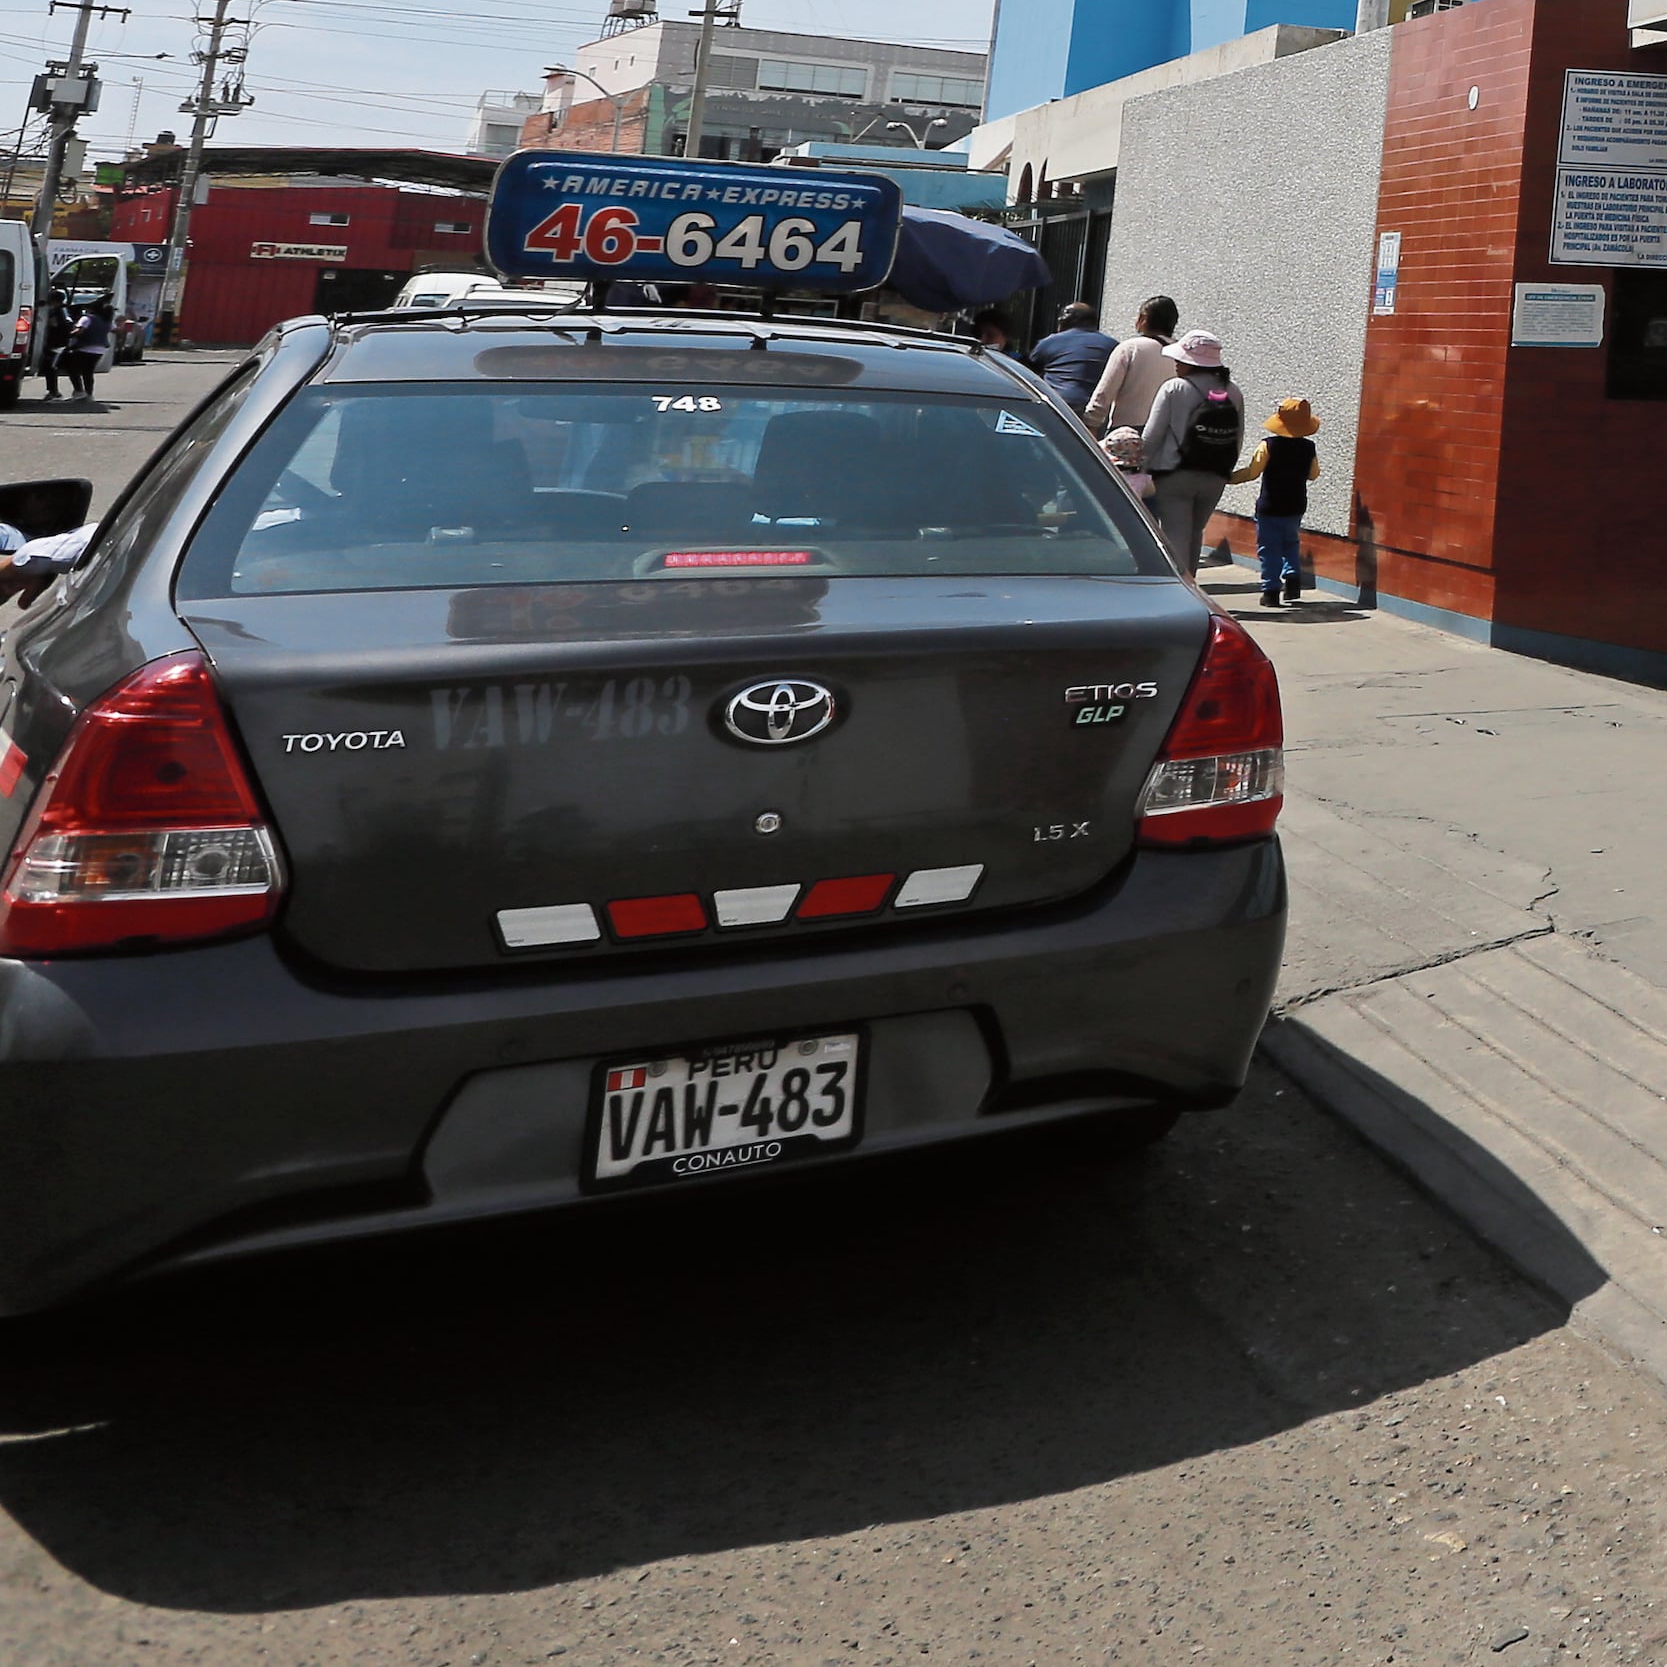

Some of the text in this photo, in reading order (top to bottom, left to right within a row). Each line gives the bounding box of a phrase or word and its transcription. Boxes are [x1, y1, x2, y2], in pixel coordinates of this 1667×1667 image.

[1574, 76, 1615, 87] INGRESO
[1617, 79, 1624, 87] A
[1565, 175, 1606, 188] INGRESO
[1608, 176, 1615, 188] A
[561, 175, 851, 211] AMERICA EXPRESS
[525, 203, 863, 273] 46-6464
[283, 247, 346, 256] ATHLETIX
[651, 395, 722, 413] 748
[1065, 682, 1158, 703] ETIOS
[429, 675, 691, 750] VAW-483
[1076, 706, 1124, 723] GLP
[282, 730, 406, 753] TOYOTA
[1070, 821, 1090, 838] X
[609, 1061, 848, 1161] VAW-483
[672, 1141, 782, 1173] CONAUTO
